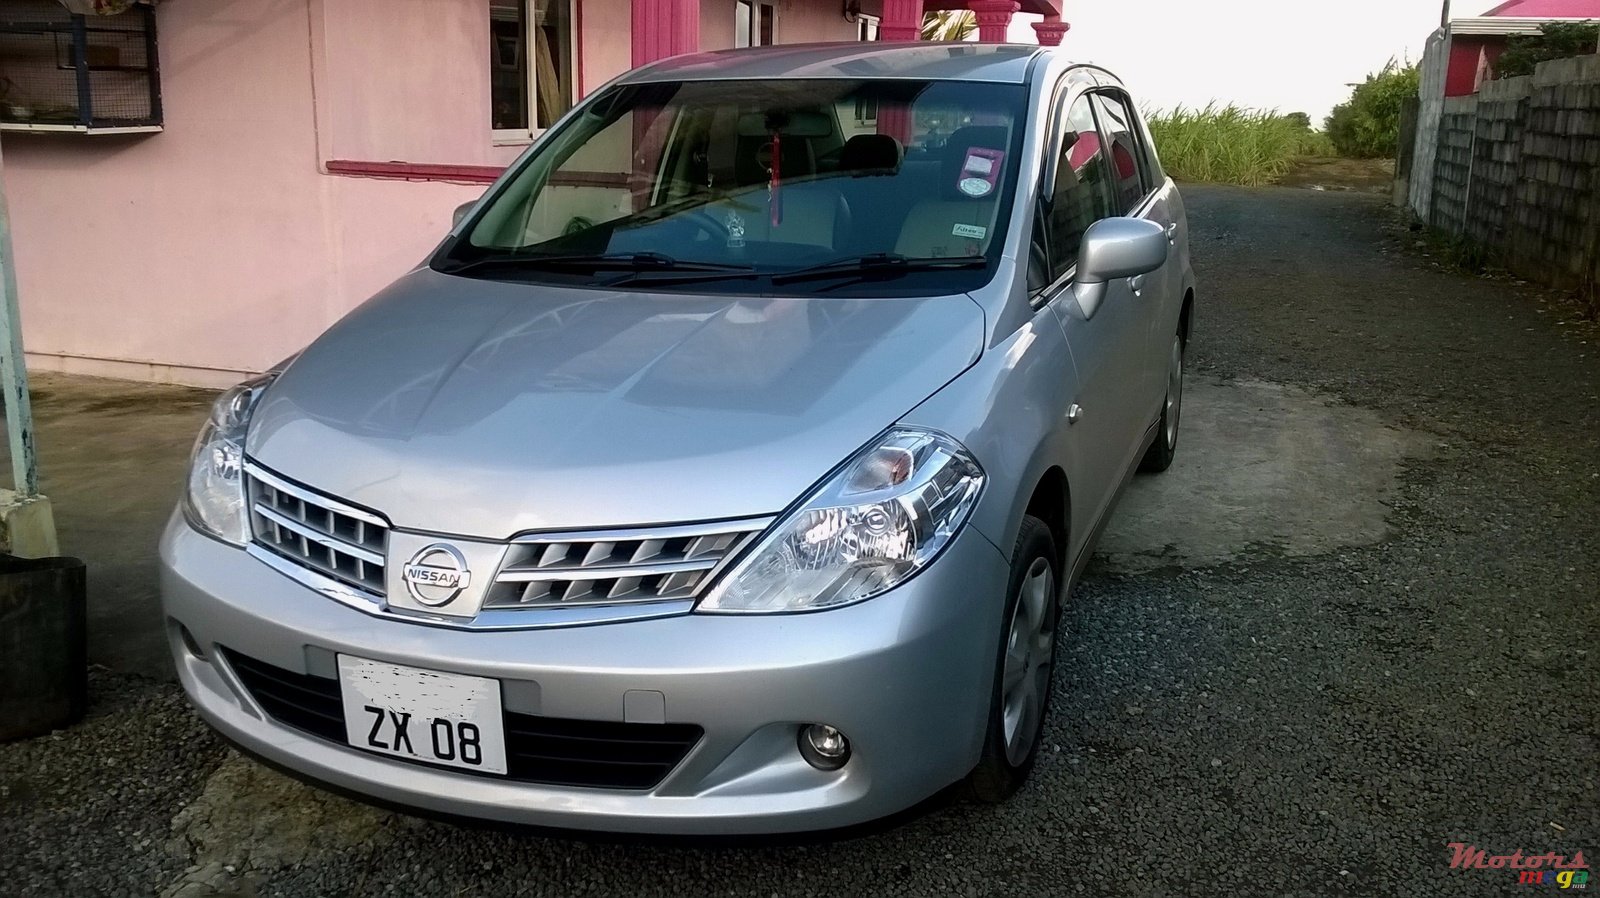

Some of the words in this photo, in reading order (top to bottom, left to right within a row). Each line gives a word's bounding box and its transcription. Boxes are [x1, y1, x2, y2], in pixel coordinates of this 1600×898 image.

[408, 568, 461, 583] NISSAN
[364, 705, 414, 754] ZX
[431, 717, 482, 766] 08
